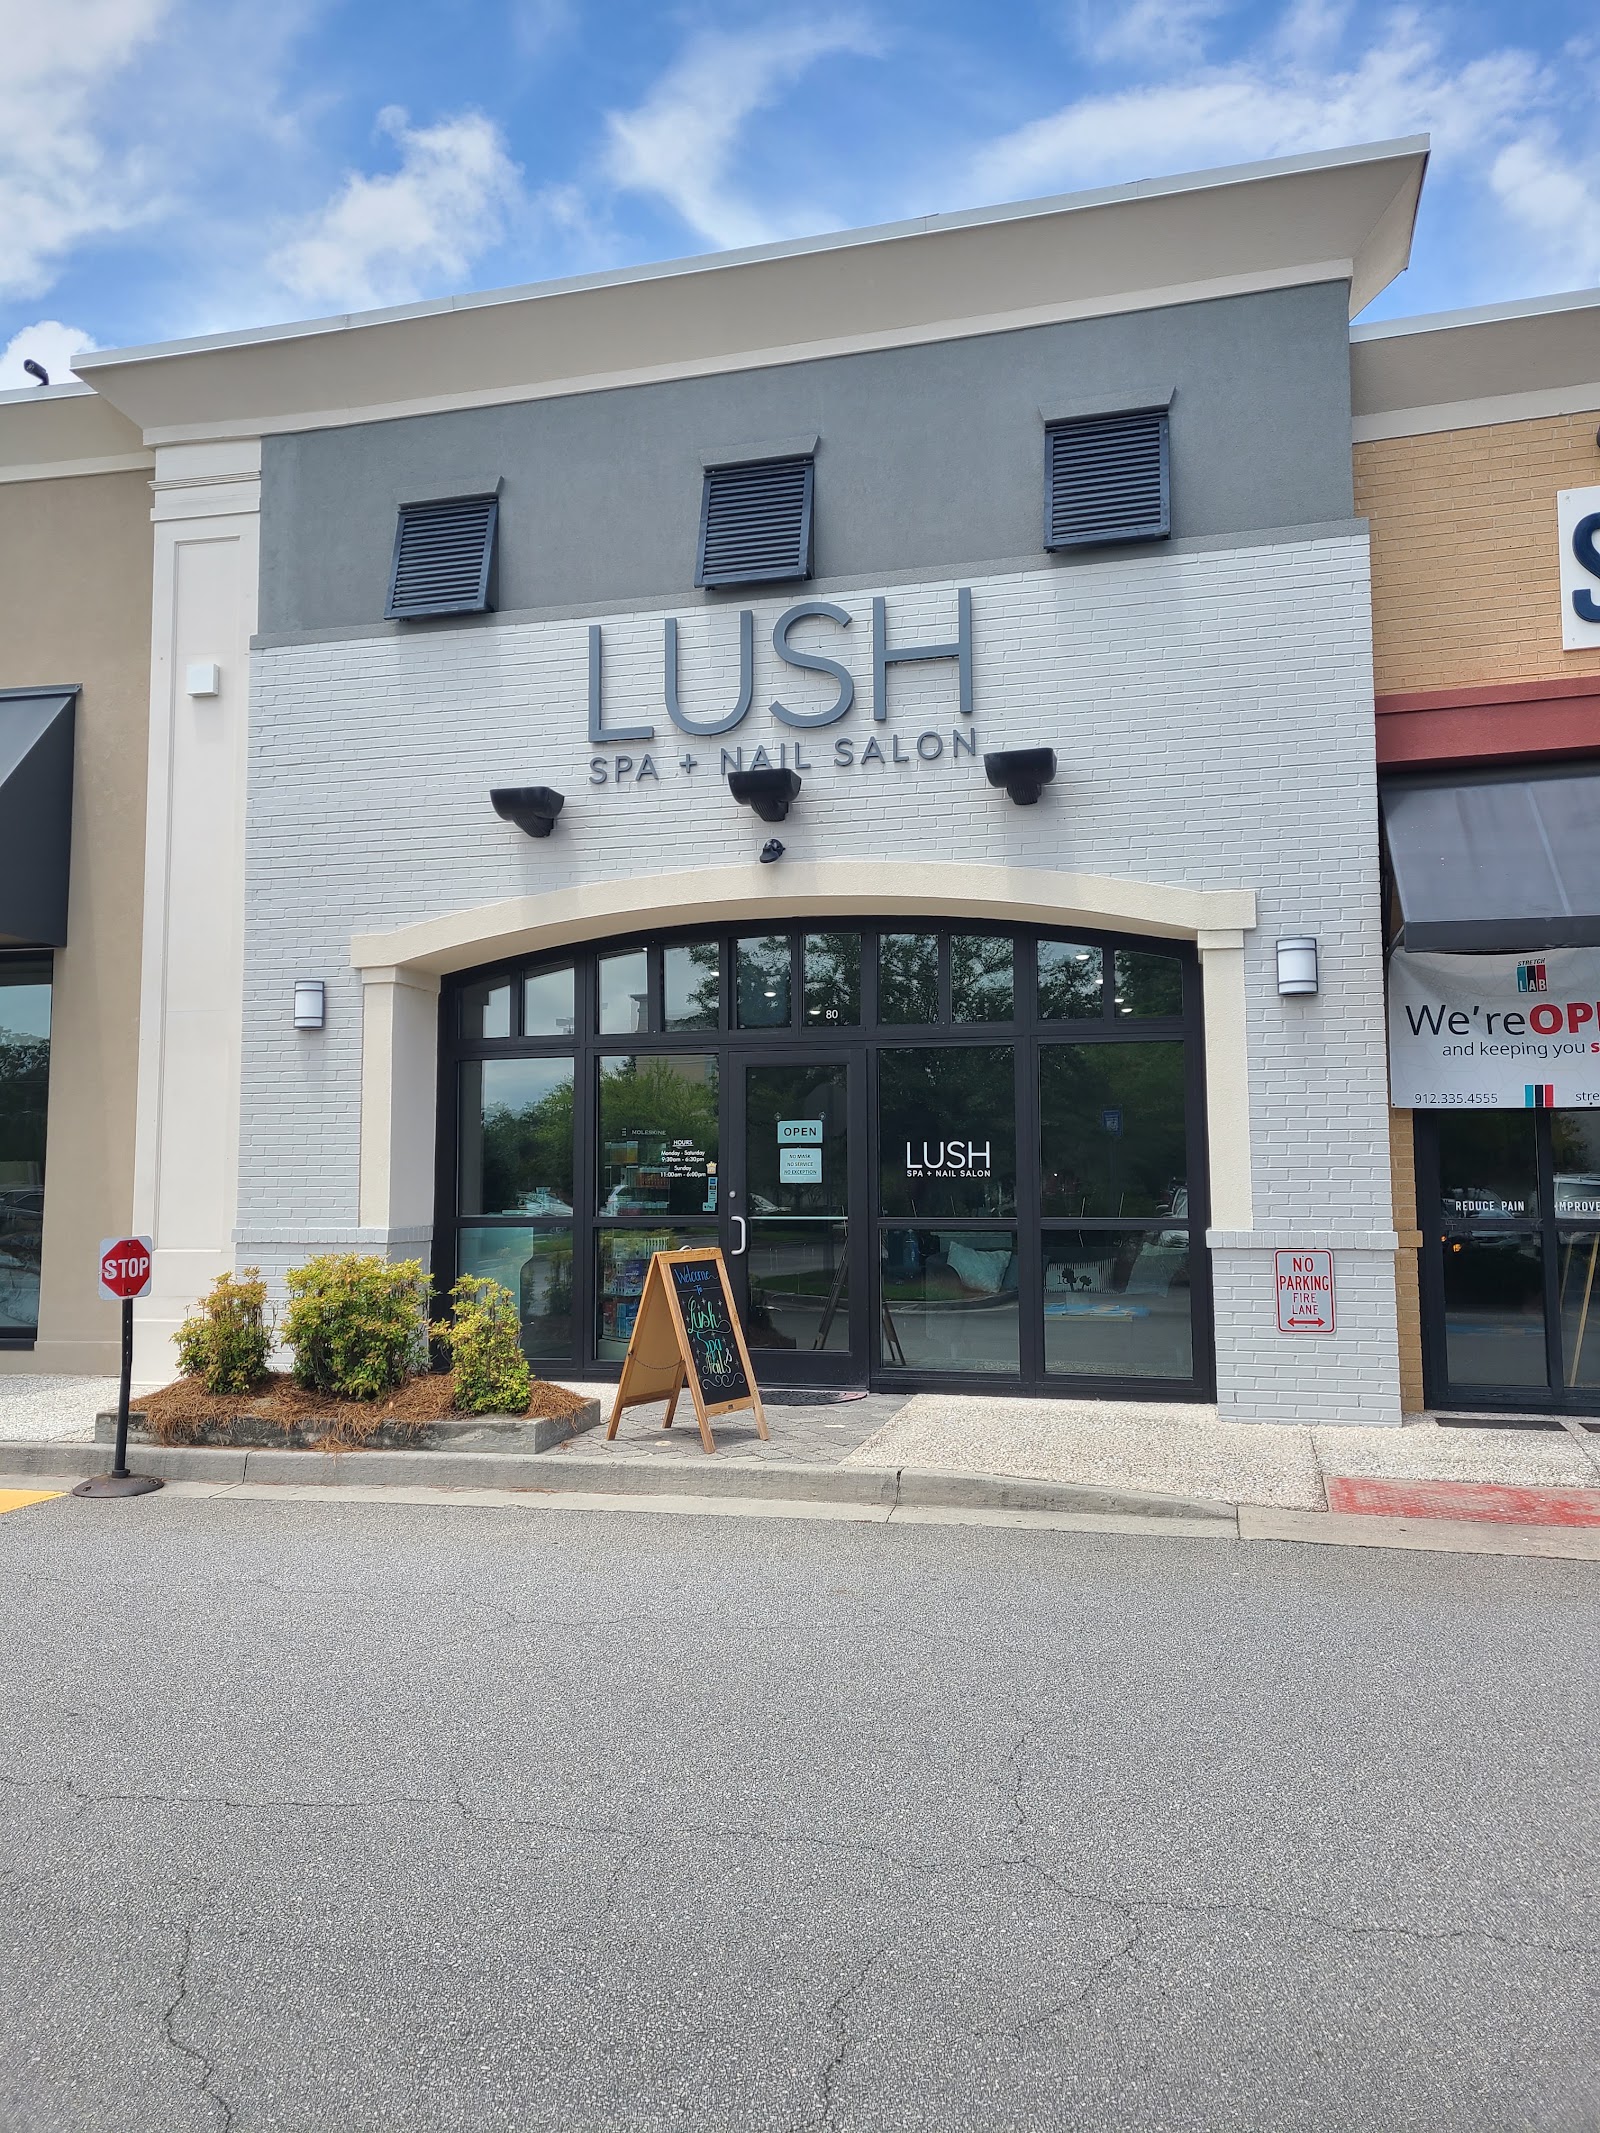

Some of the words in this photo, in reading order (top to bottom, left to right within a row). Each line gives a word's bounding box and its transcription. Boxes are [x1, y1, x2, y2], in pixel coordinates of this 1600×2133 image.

[588, 587, 973, 743] LUSH
[589, 753, 659, 785] SPA
[679, 754, 697, 774] +
[720, 742, 811, 776] NAIL
[834, 727, 977, 767] SALON
[1519, 979, 1546, 992] LAB
[825, 1010, 838, 1020] 80
[1405, 1004, 1526, 1036] We're
[1529, 1002, 1600, 1036] OP
[1442, 1042, 1474, 1057] and
[1480, 1041, 1548, 1059] keeping
[1553, 1043, 1585, 1059] you
[1414, 1092, 1499, 1105] 912.335.4555
[783, 1127, 817, 1136] OPEN
[906, 1141, 990, 1168] LUSH
[1455, 1200, 1495, 1212] REDUCE
[1501, 1200, 1525, 1212] PAIN
[1554, 1201, 1600, 1212] IMPROVE
[104, 1257, 149, 1280] STOP
[1293, 1257, 1314, 1273] NO
[674, 1265, 718, 1284] Welcome
[1279, 1275, 1329, 1291] PARKING
[1293, 1293, 1317, 1303] FIRE
[687, 1296, 726, 1334] Lush
[1292, 1305, 1319, 1315] LANE
[696, 1331, 722, 1361] Spa
